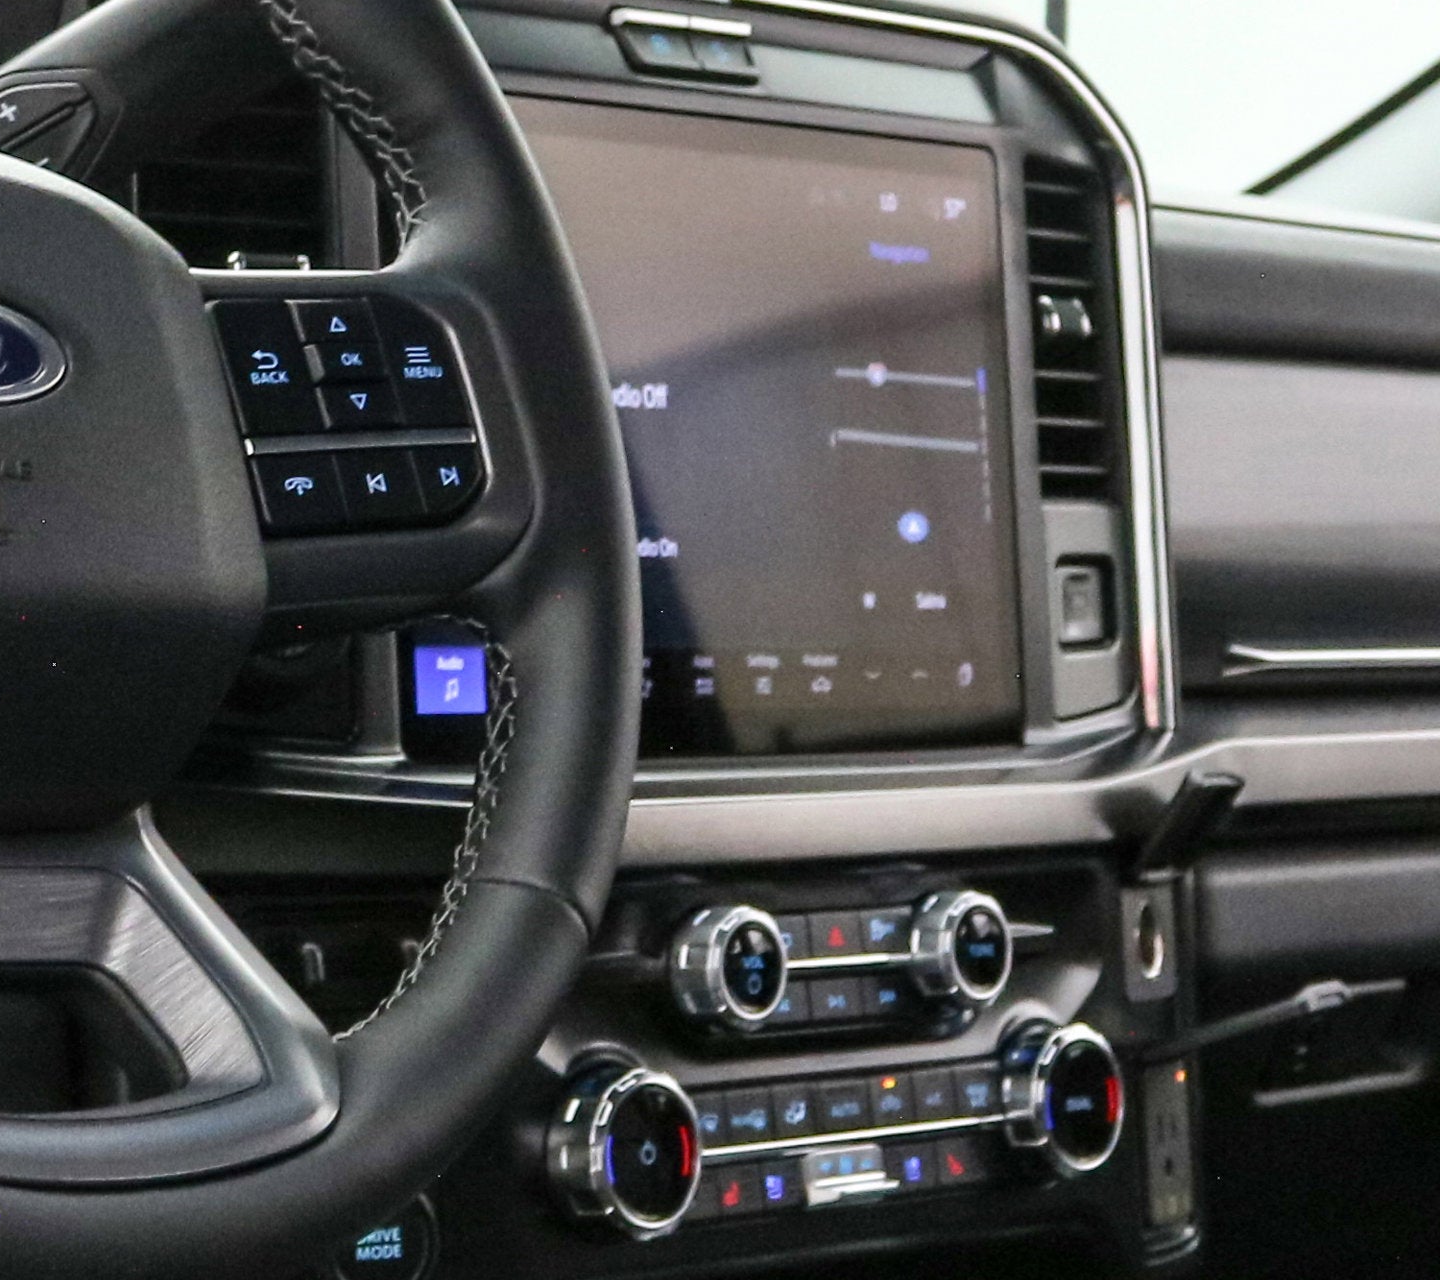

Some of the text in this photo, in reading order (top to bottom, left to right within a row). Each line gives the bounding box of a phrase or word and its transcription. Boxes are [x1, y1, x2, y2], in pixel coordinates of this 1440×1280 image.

[340, 352, 363, 367] OK
[249, 370, 290, 386] BACK
[403, 365, 444, 380] MENU
[355, 1244, 403, 1261] MODE
